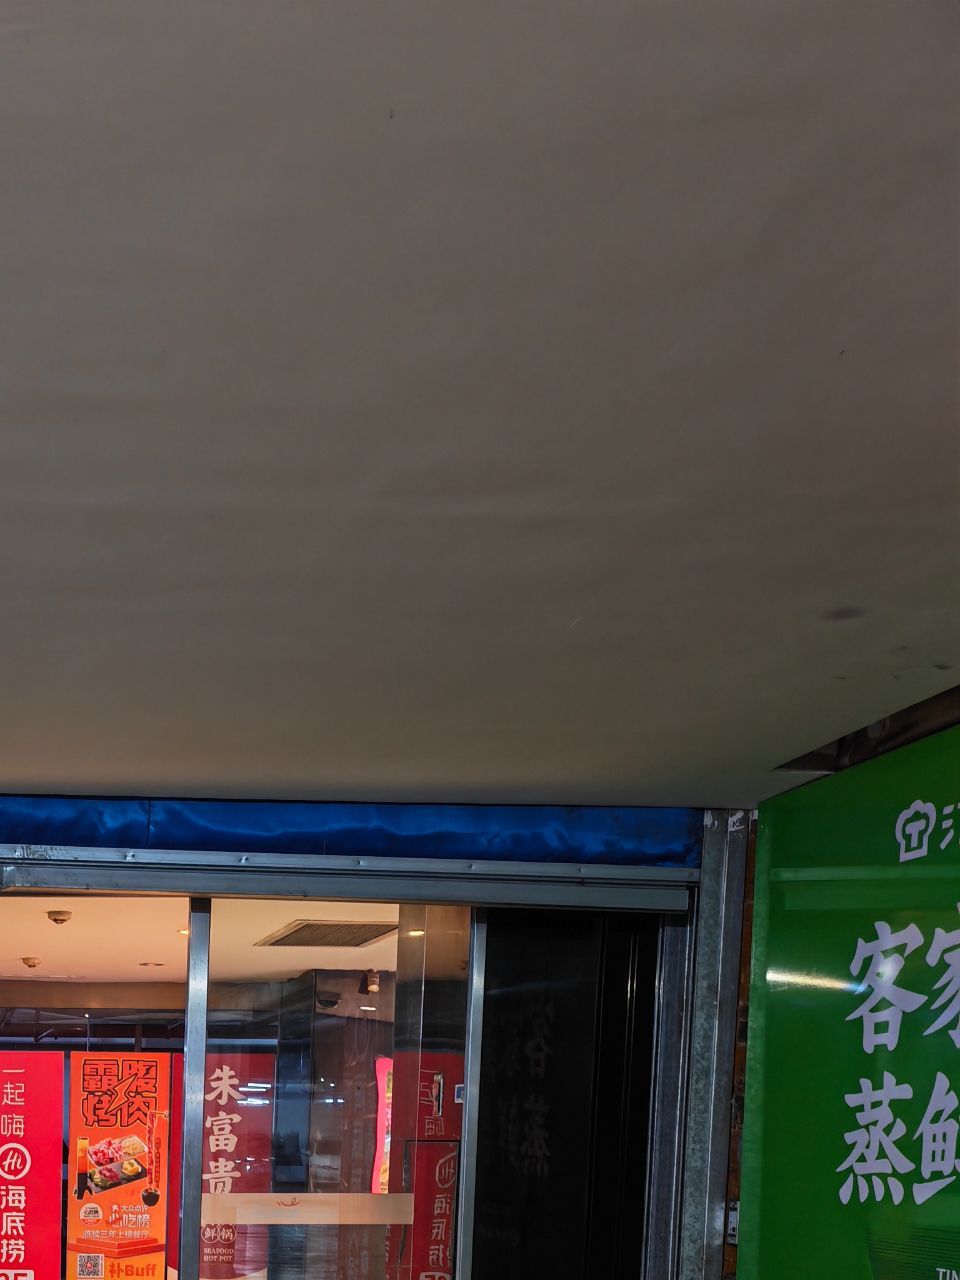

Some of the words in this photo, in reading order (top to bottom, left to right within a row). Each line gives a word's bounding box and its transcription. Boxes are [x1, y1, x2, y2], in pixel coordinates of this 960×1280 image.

[1, 1069, 25, 1138] 一起嗨
[202, 1064, 246, 1193] 朱富贵
[2, 1150, 23, 1172] Hi
[121, 1204, 148, 1212] 大众点评
[0, 1185, 26, 1263] 海底捞
[109, 1213, 151, 1228] 必吃榜
[204, 1247, 235, 1255] SEAFOOD
[109, 1262, 157, 1279] 补Buff
